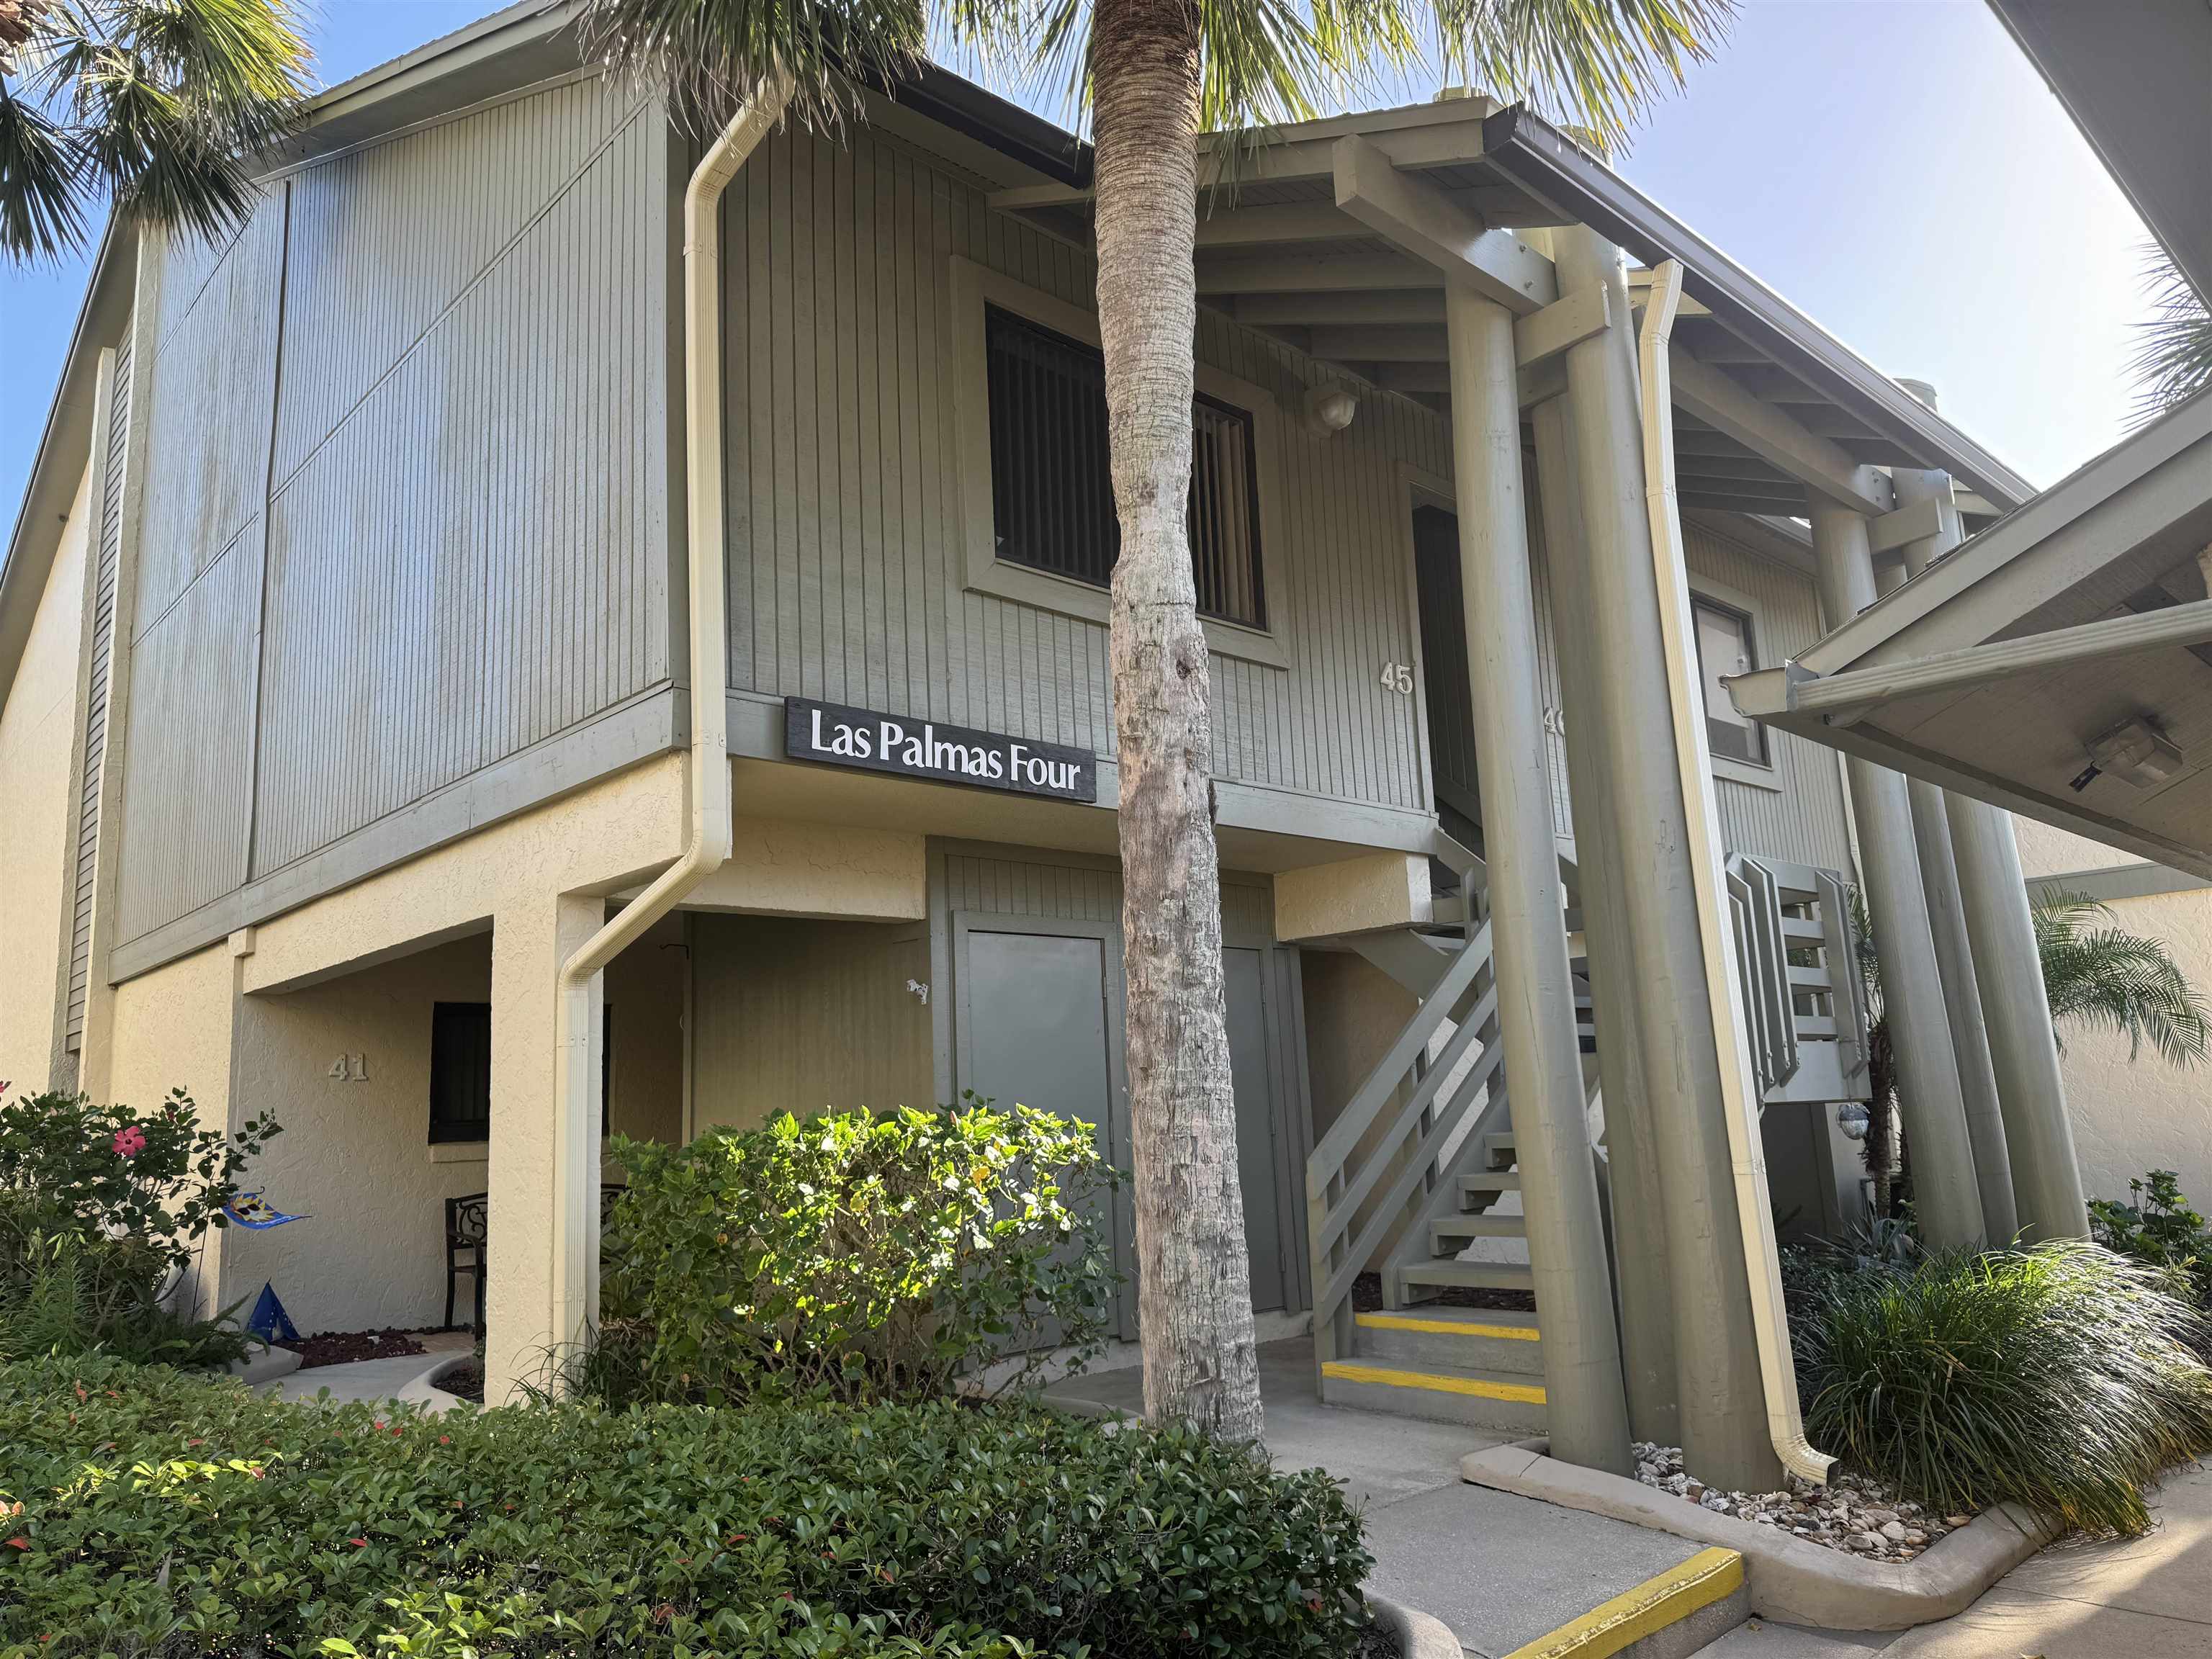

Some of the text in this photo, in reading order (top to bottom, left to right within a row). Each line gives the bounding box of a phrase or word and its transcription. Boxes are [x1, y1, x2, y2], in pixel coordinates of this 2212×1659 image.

[1380, 662, 1413, 695] 45
[811, 709, 1081, 790] Las Palmas Four
[328, 1053, 368, 1082] 41
